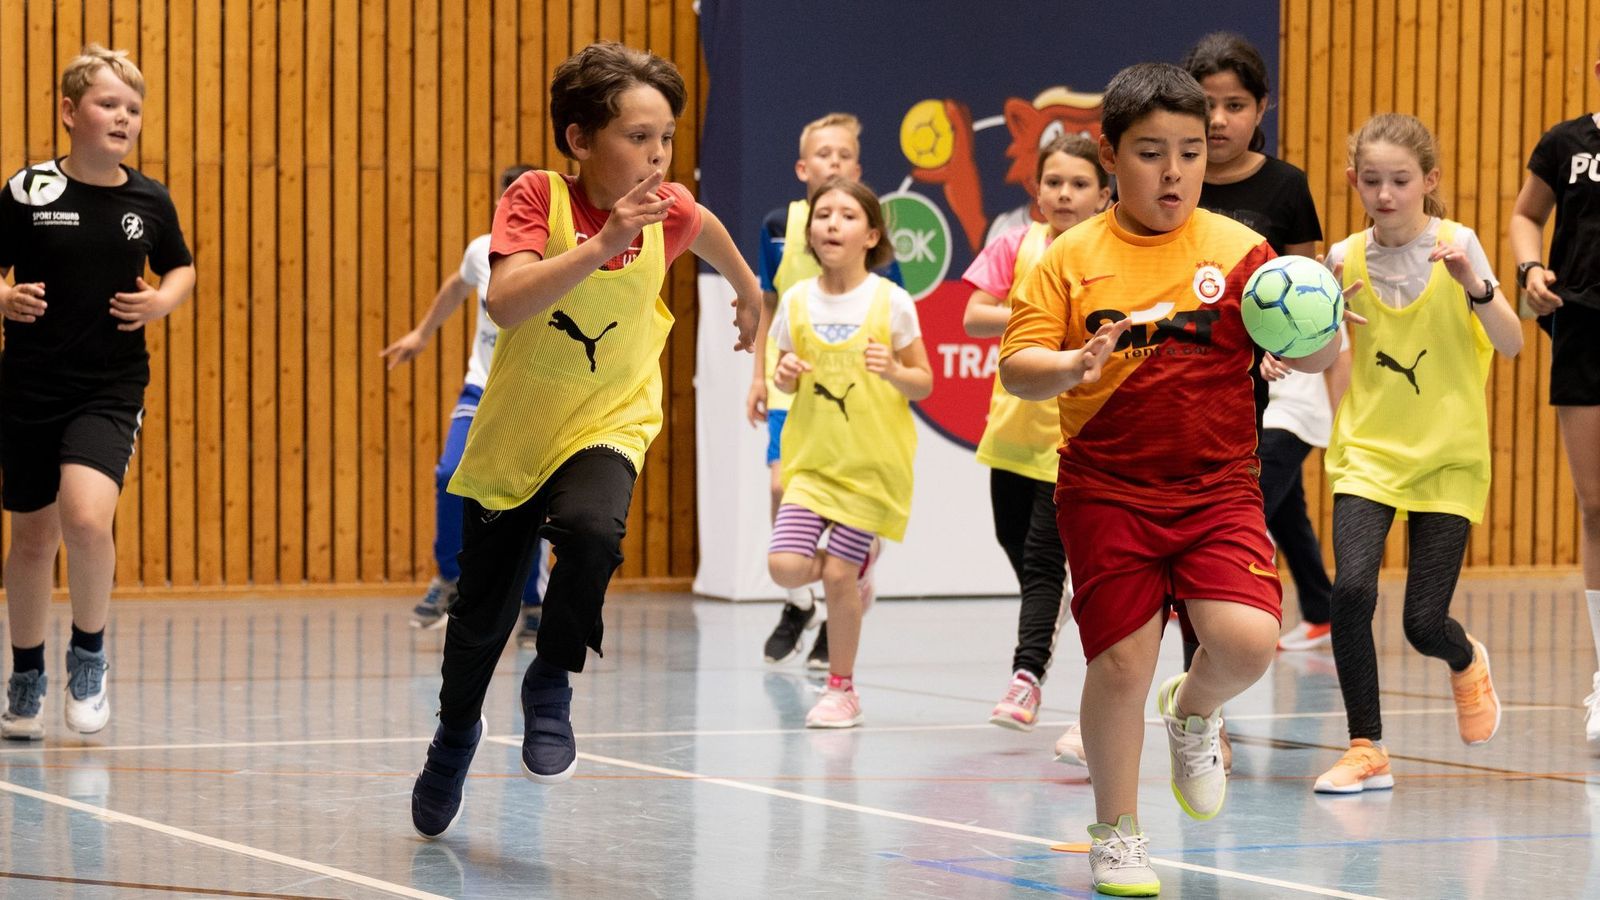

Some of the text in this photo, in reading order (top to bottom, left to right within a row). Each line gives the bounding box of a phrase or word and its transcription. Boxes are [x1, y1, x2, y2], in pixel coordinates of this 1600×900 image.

[33, 211, 80, 221] SPORT SCHWAB
[888, 228, 937, 263] OK
[1123, 345, 1162, 360] rent
